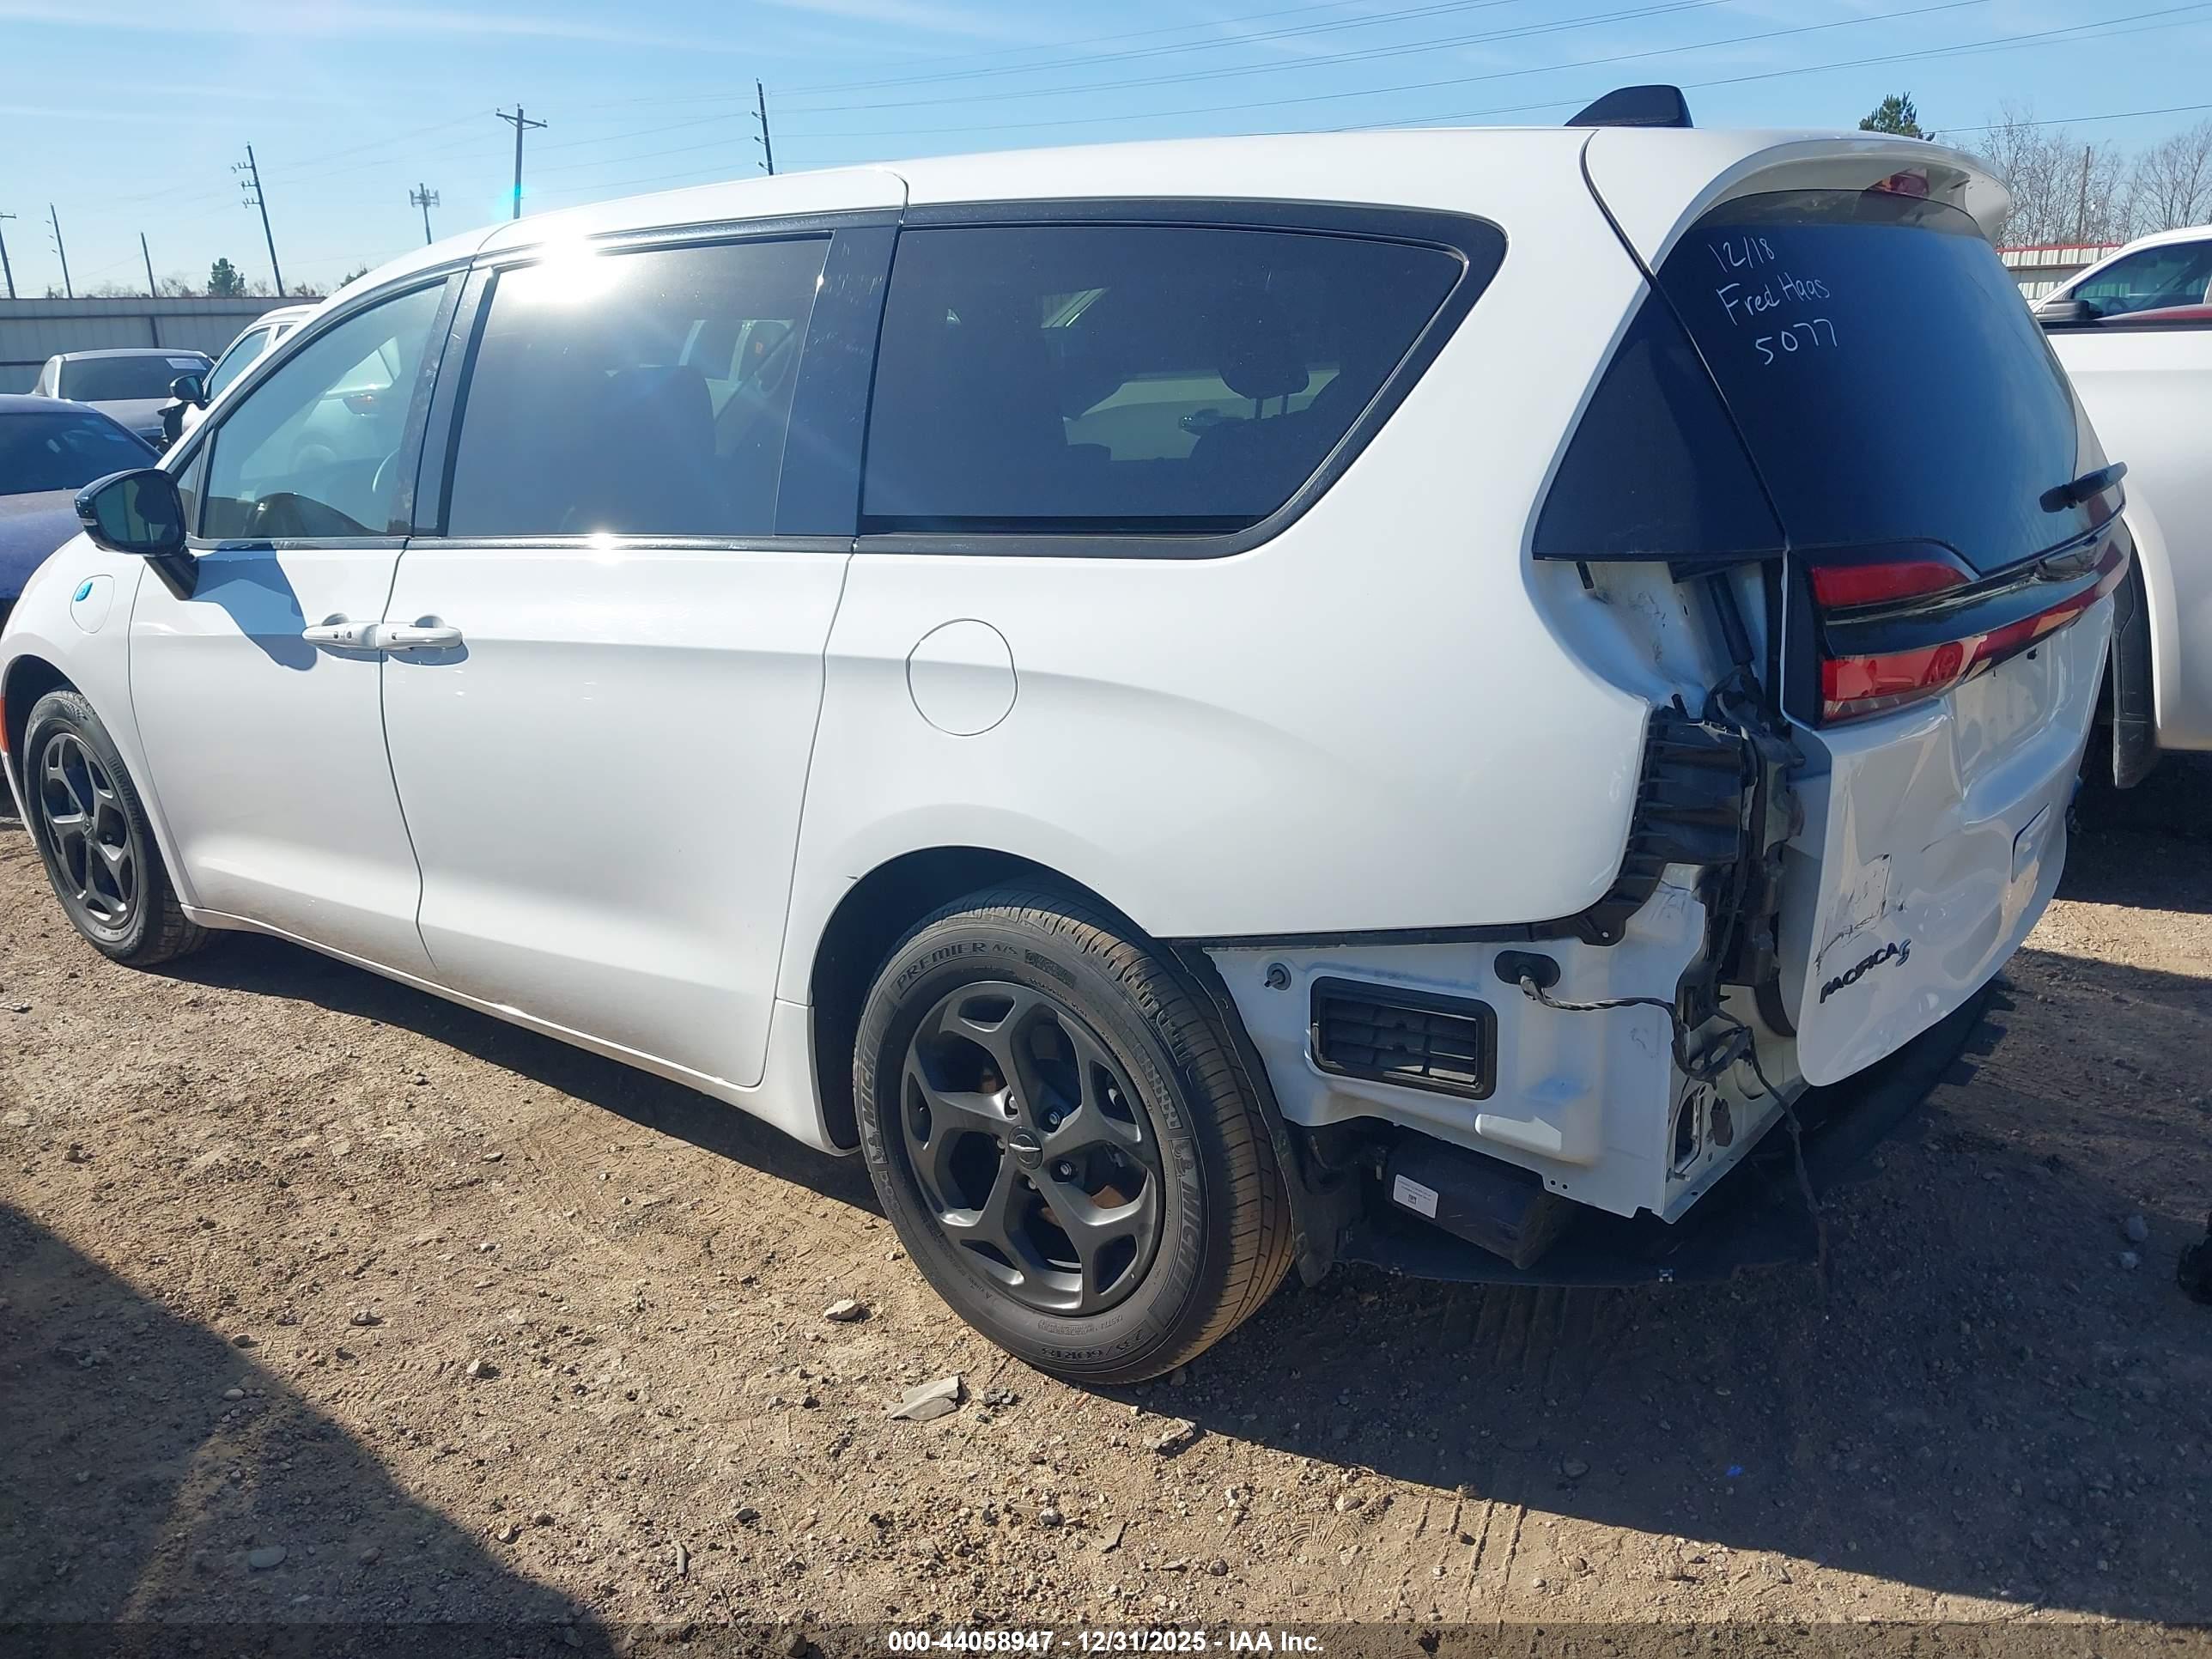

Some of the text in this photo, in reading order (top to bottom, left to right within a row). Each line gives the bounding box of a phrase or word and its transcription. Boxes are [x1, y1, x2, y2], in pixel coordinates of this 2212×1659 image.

[1708, 236, 1775, 273] 12/18
[1716, 271, 1831, 326] Fred Haas
[1754, 319, 1838, 365] 5077
